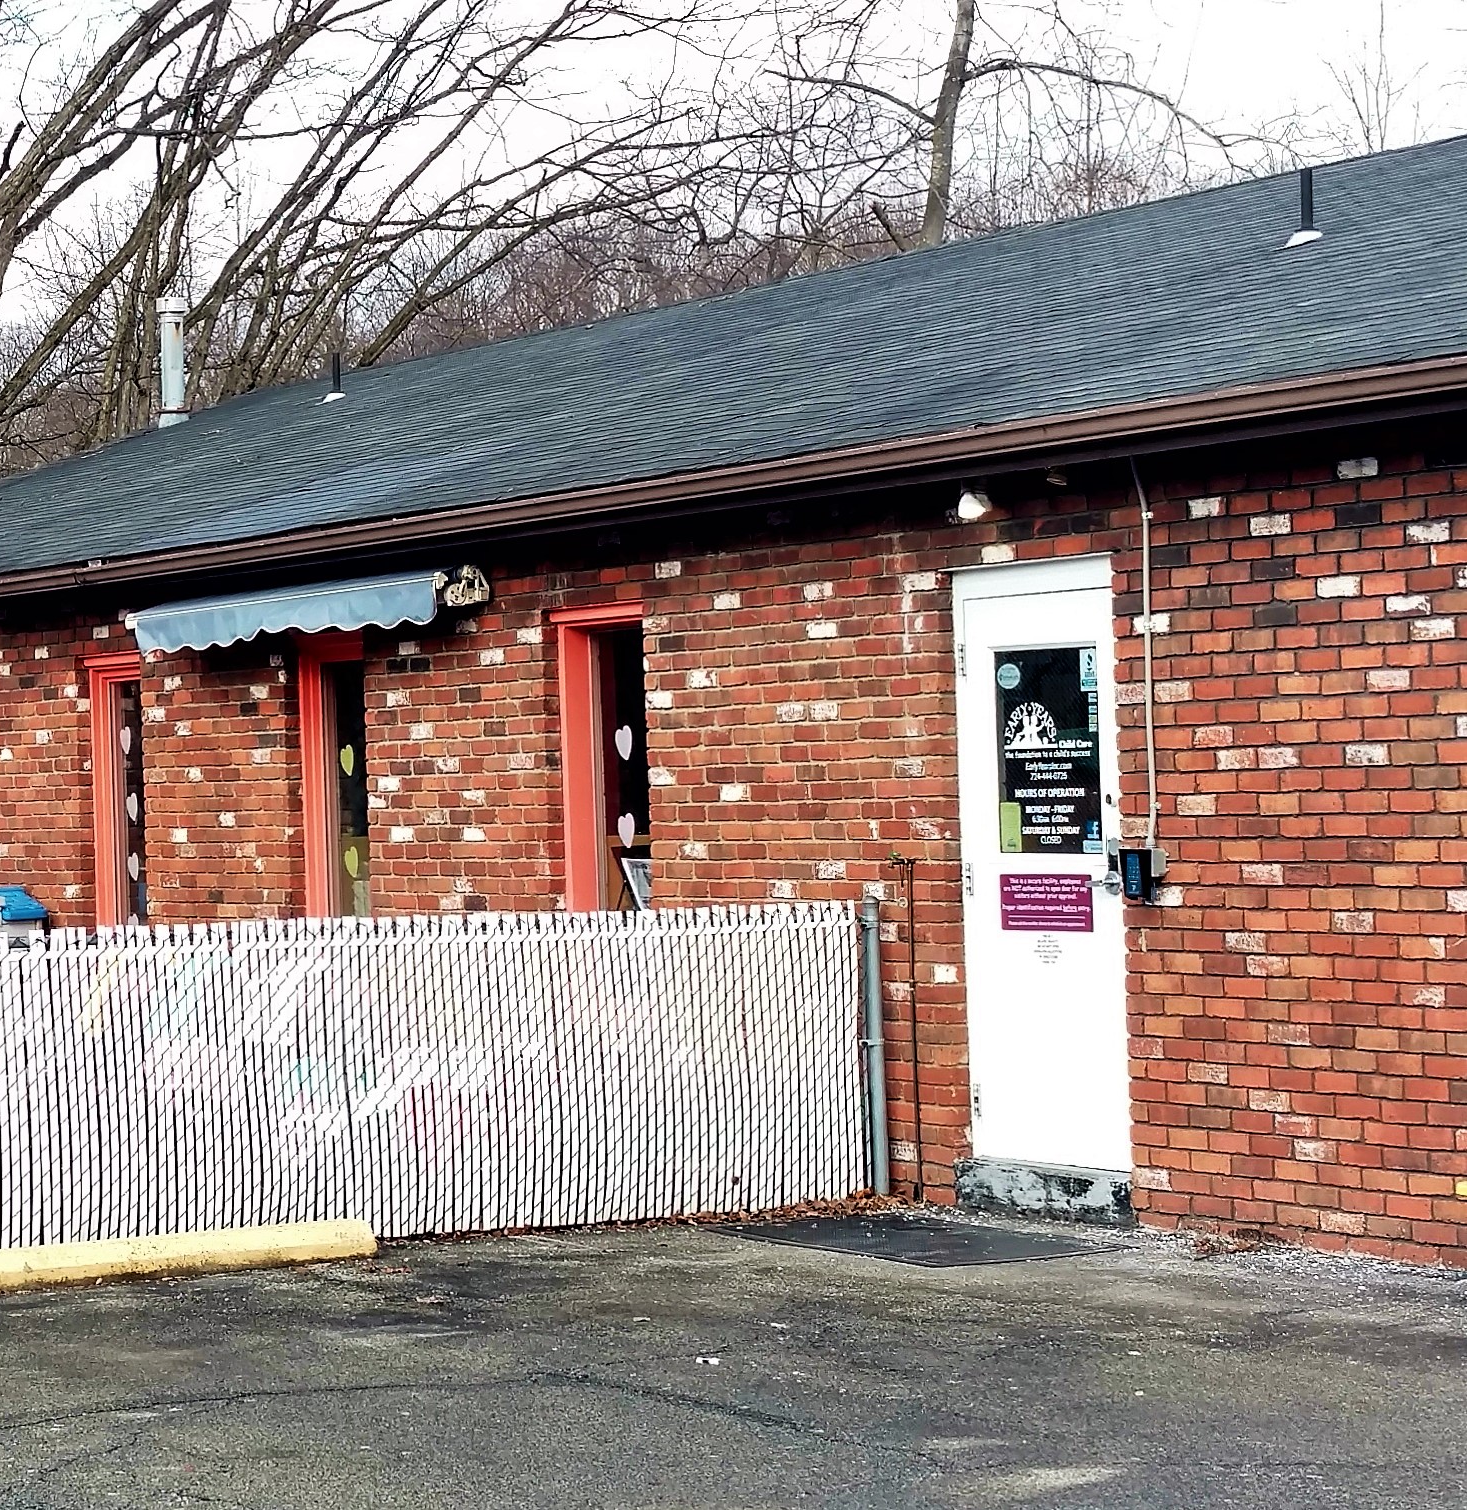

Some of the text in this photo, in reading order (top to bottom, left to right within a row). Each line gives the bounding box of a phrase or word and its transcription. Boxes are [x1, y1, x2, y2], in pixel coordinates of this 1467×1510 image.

[1005, 701, 1057, 740] EARLY YEARS
[1059, 739, 1093, 748] Child Care
[1014, 787, 1085, 798] HOURS OF OPERATION
[1025, 805, 1051, 813] MONDAY
[1053, 805, 1075, 813] FRIDAY
[1056, 826, 1081, 834] SUNDAY
[1040, 836, 1062, 845] CLOSED
